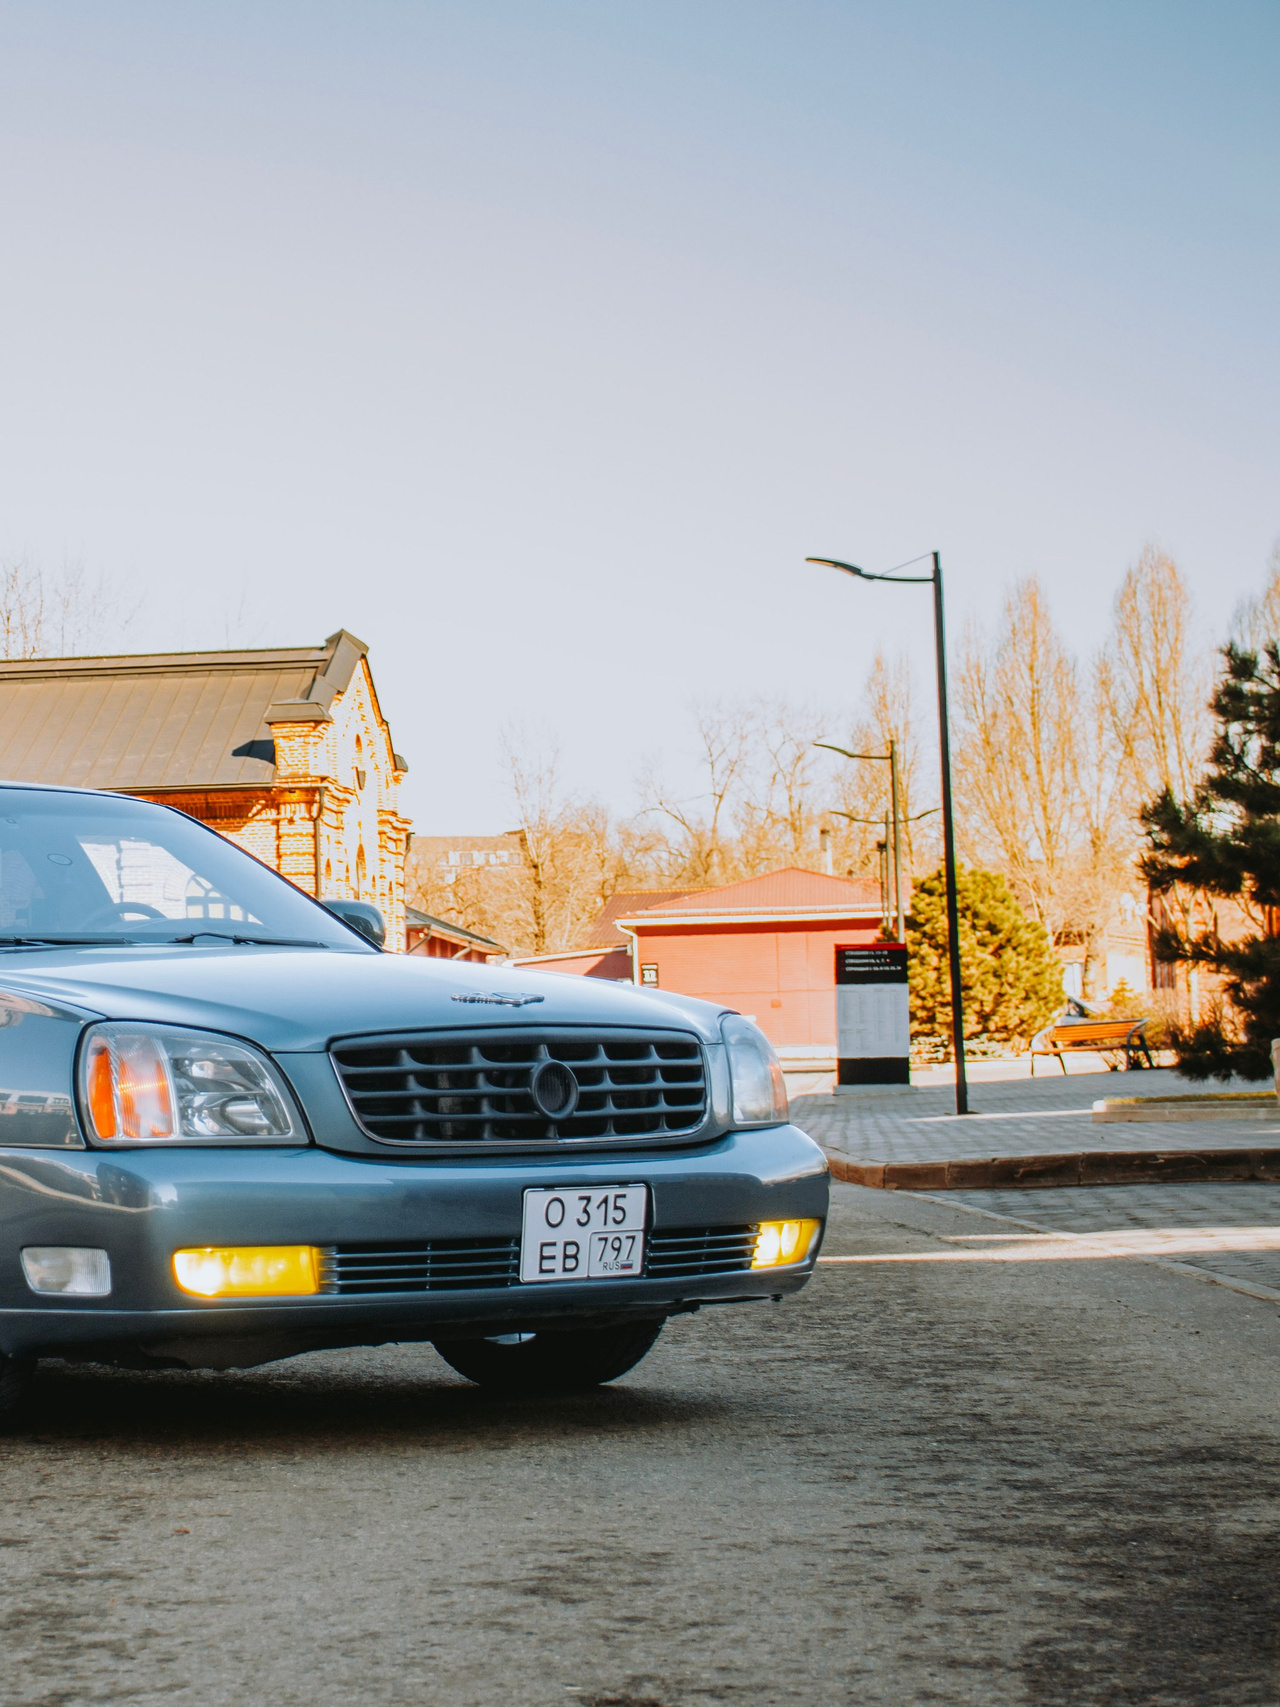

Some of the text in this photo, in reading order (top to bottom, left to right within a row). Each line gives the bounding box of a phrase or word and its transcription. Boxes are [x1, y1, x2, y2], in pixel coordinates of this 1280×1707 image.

[545, 1193, 627, 1228] O 315
[538, 1240, 580, 1274] EB
[597, 1235, 636, 1262] 797
[602, 1261, 620, 1271] RUS
